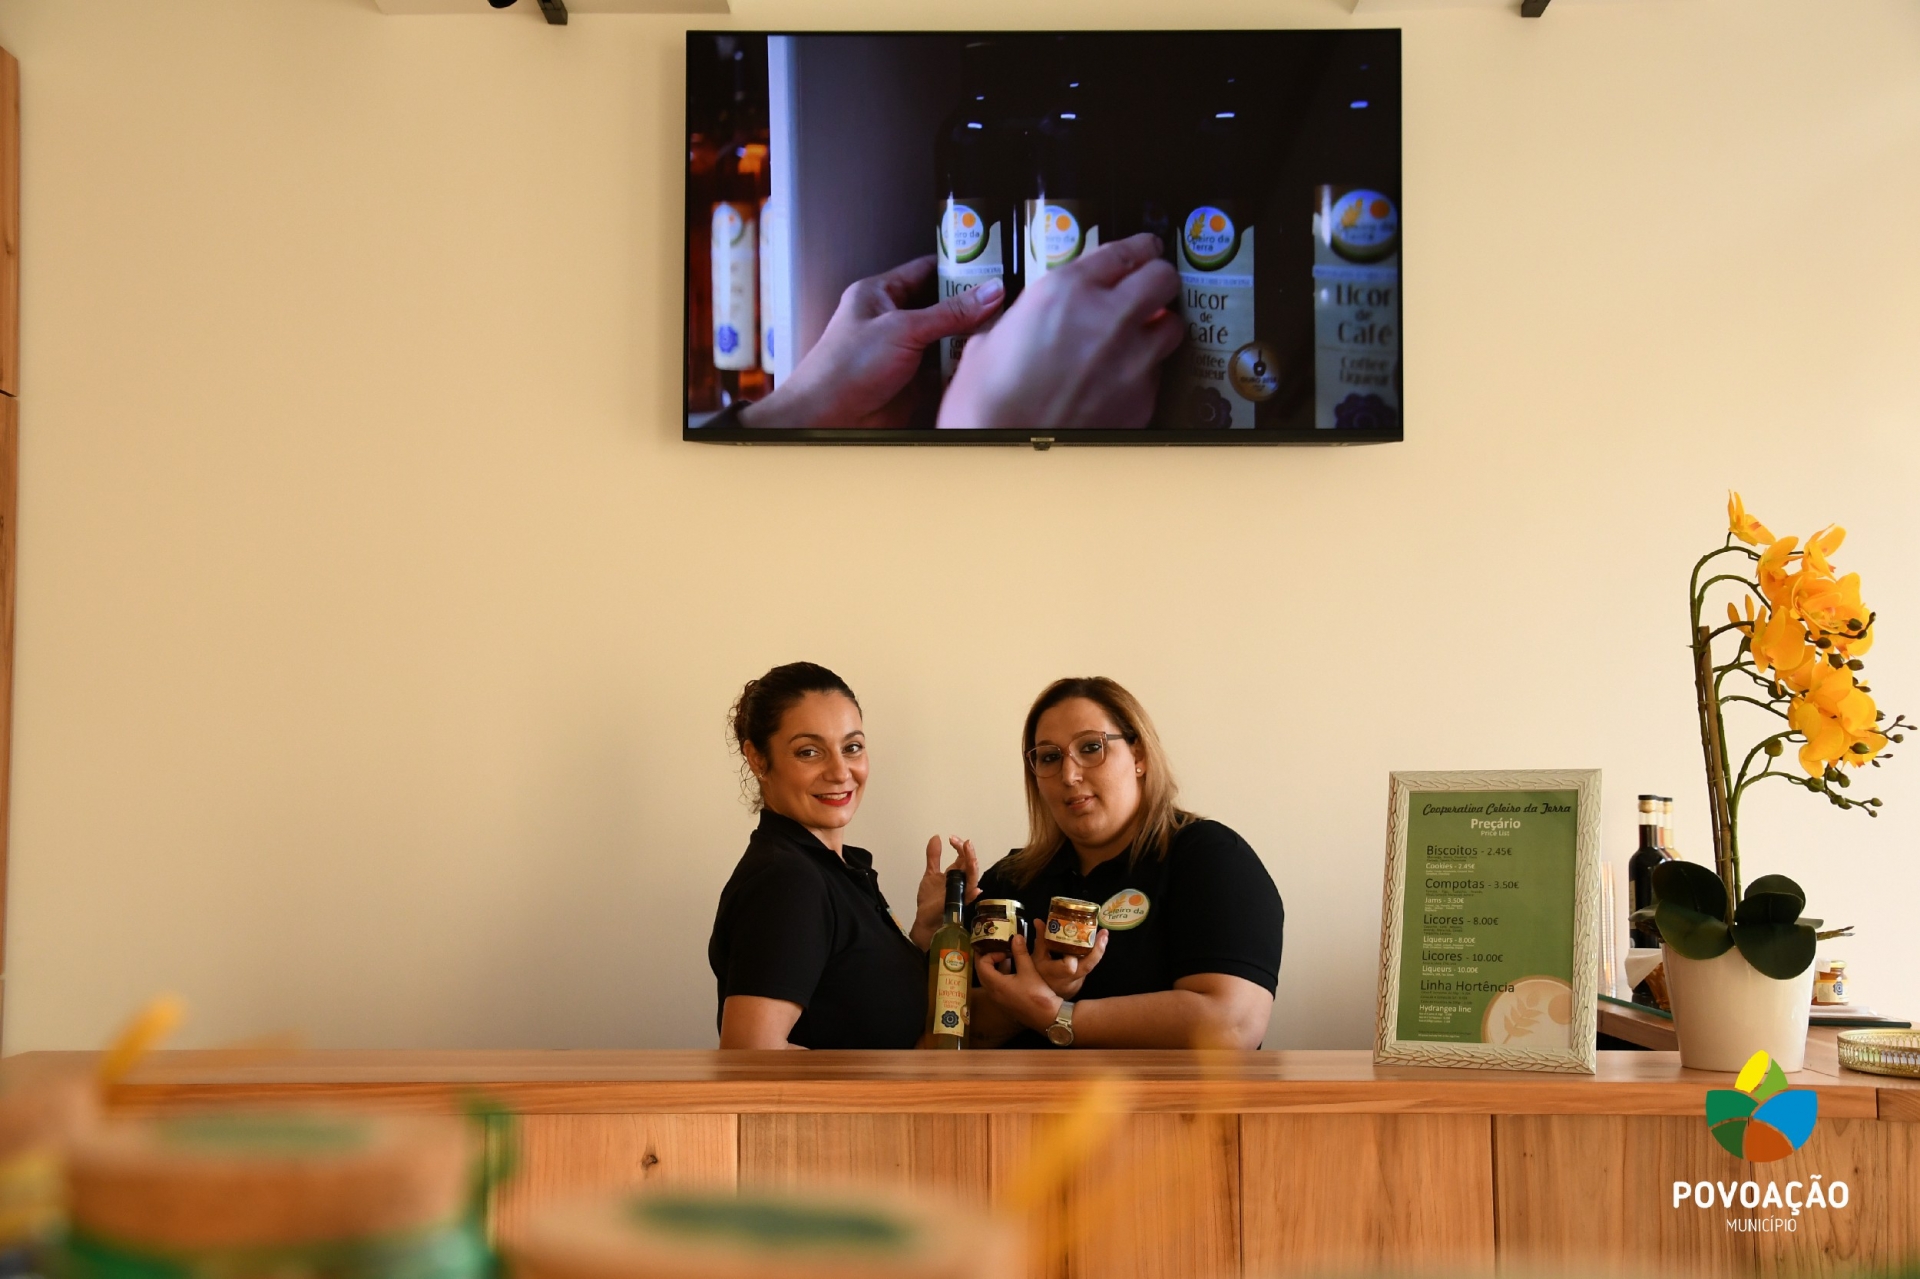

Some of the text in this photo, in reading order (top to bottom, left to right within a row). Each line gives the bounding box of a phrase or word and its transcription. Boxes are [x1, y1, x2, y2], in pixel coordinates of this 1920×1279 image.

[970, 229, 980, 238] da
[1218, 234, 1230, 243] da
[1192, 241, 1214, 252] Terra
[946, 280, 977, 297] Lico
[1187, 288, 1229, 310] Licor
[1337, 283, 1391, 307] Licor
[1200, 312, 1212, 323] de
[1188, 322, 1228, 344] Café
[1338, 322, 1393, 345] Café
[1423, 802, 1571, 816] Cooperativa Celeiro da Terra
[1470, 818, 1521, 830] Preçário
[1426, 845, 1478, 856] Biscoitos
[1487, 847, 1512, 856] 2.45€
[1425, 878, 1485, 891] Compotas
[1494, 880, 1520, 889] 3.50€
[1423, 914, 1464, 925] Licores
[1473, 917, 1499, 926] 8.00€
[1423, 935, 1453, 944] Liqueurs
[1422, 950, 1463, 961] Licores
[1472, 953, 1503, 962] 10.00€
[1422, 965, 1452, 973] Liqueurs
[1420, 980, 1515, 993] Linha Hortência
[1419, 1004, 1472, 1014] Hydrangea line
